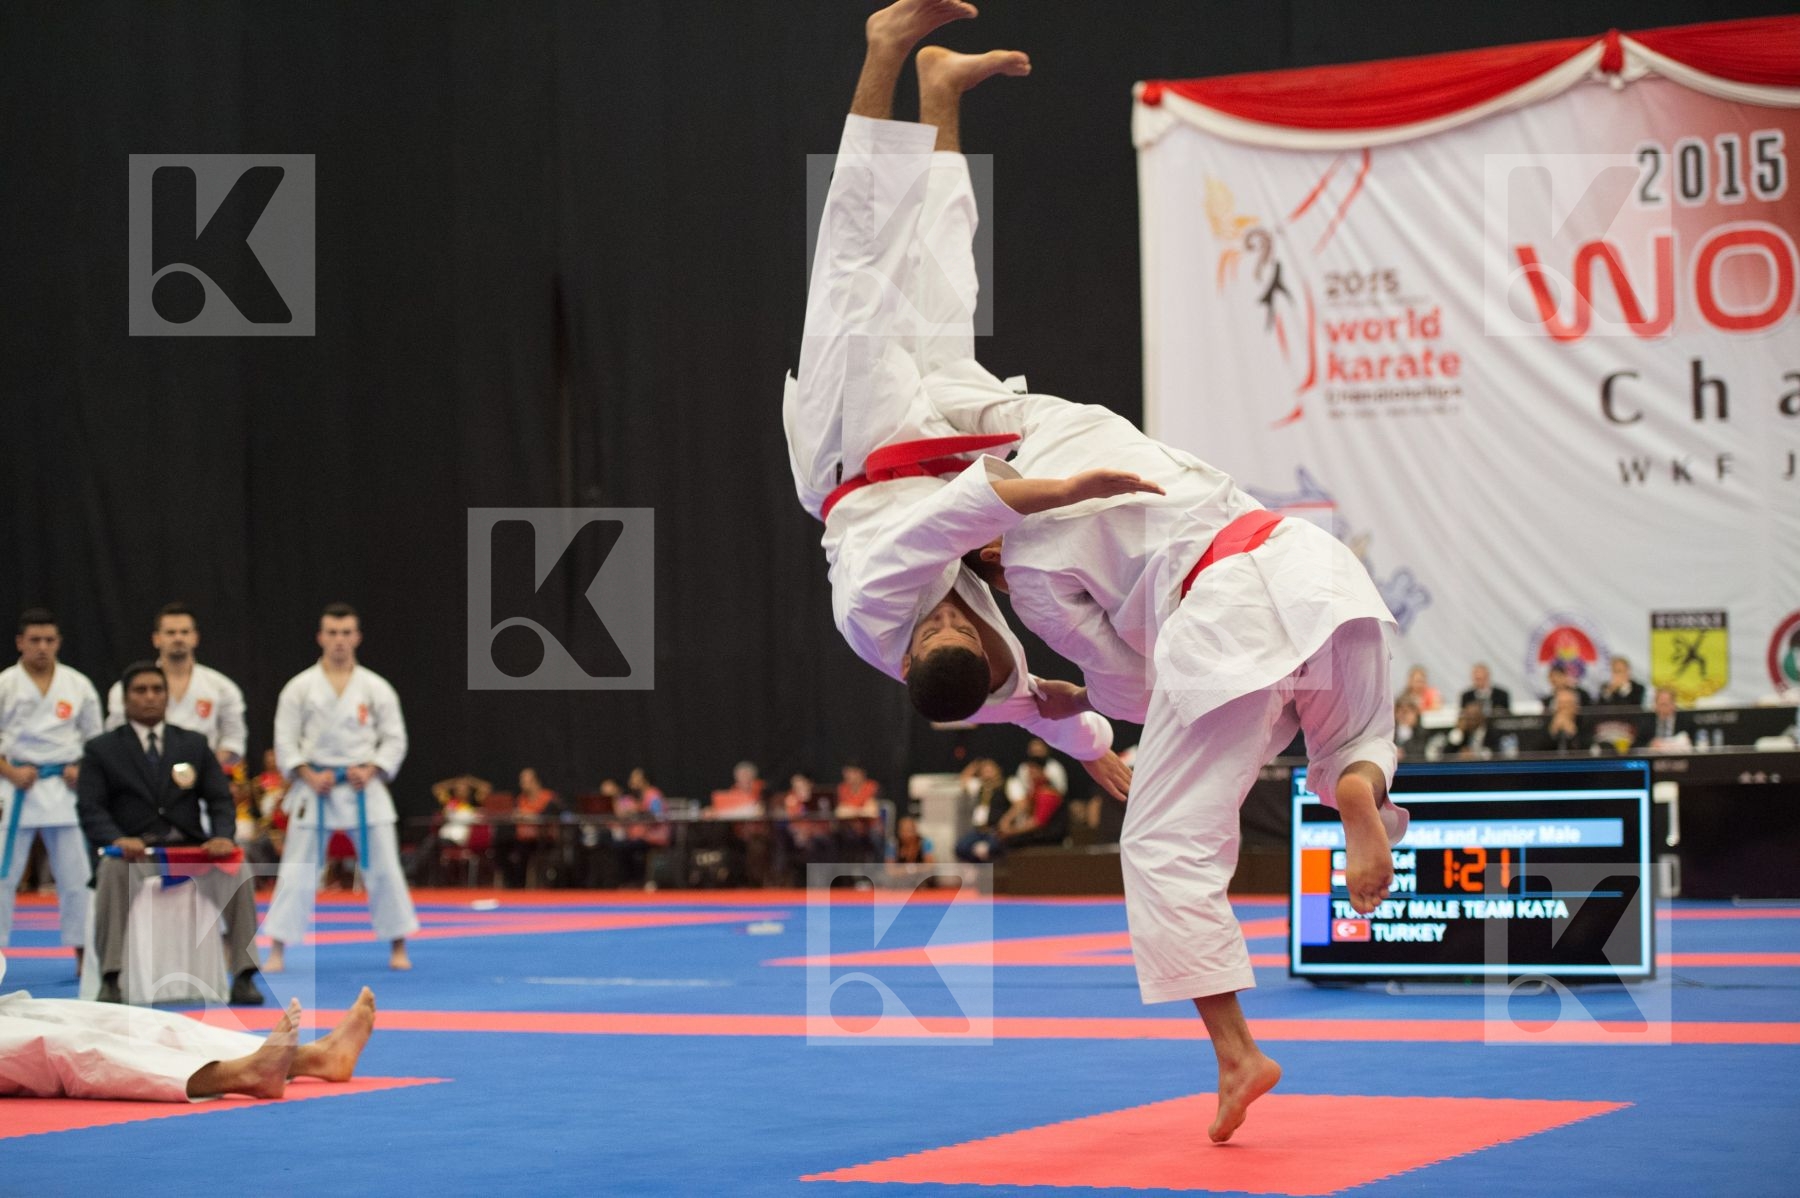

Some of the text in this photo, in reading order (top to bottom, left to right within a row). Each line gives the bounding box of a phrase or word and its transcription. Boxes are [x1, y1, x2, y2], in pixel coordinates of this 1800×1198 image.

[1637, 136, 1781, 204] 2015
[1326, 270, 1398, 297] 2015
[1326, 306, 1441, 342] world
[1328, 349, 1461, 381] karate
[1301, 825, 1581, 845] Kata adet and Junior Male
[1408, 901, 1460, 919] MALE
[1463, 900, 1514, 918] TEAM
[1516, 900, 1569, 918] KATA
[1371, 923, 1447, 942] TURKEY
